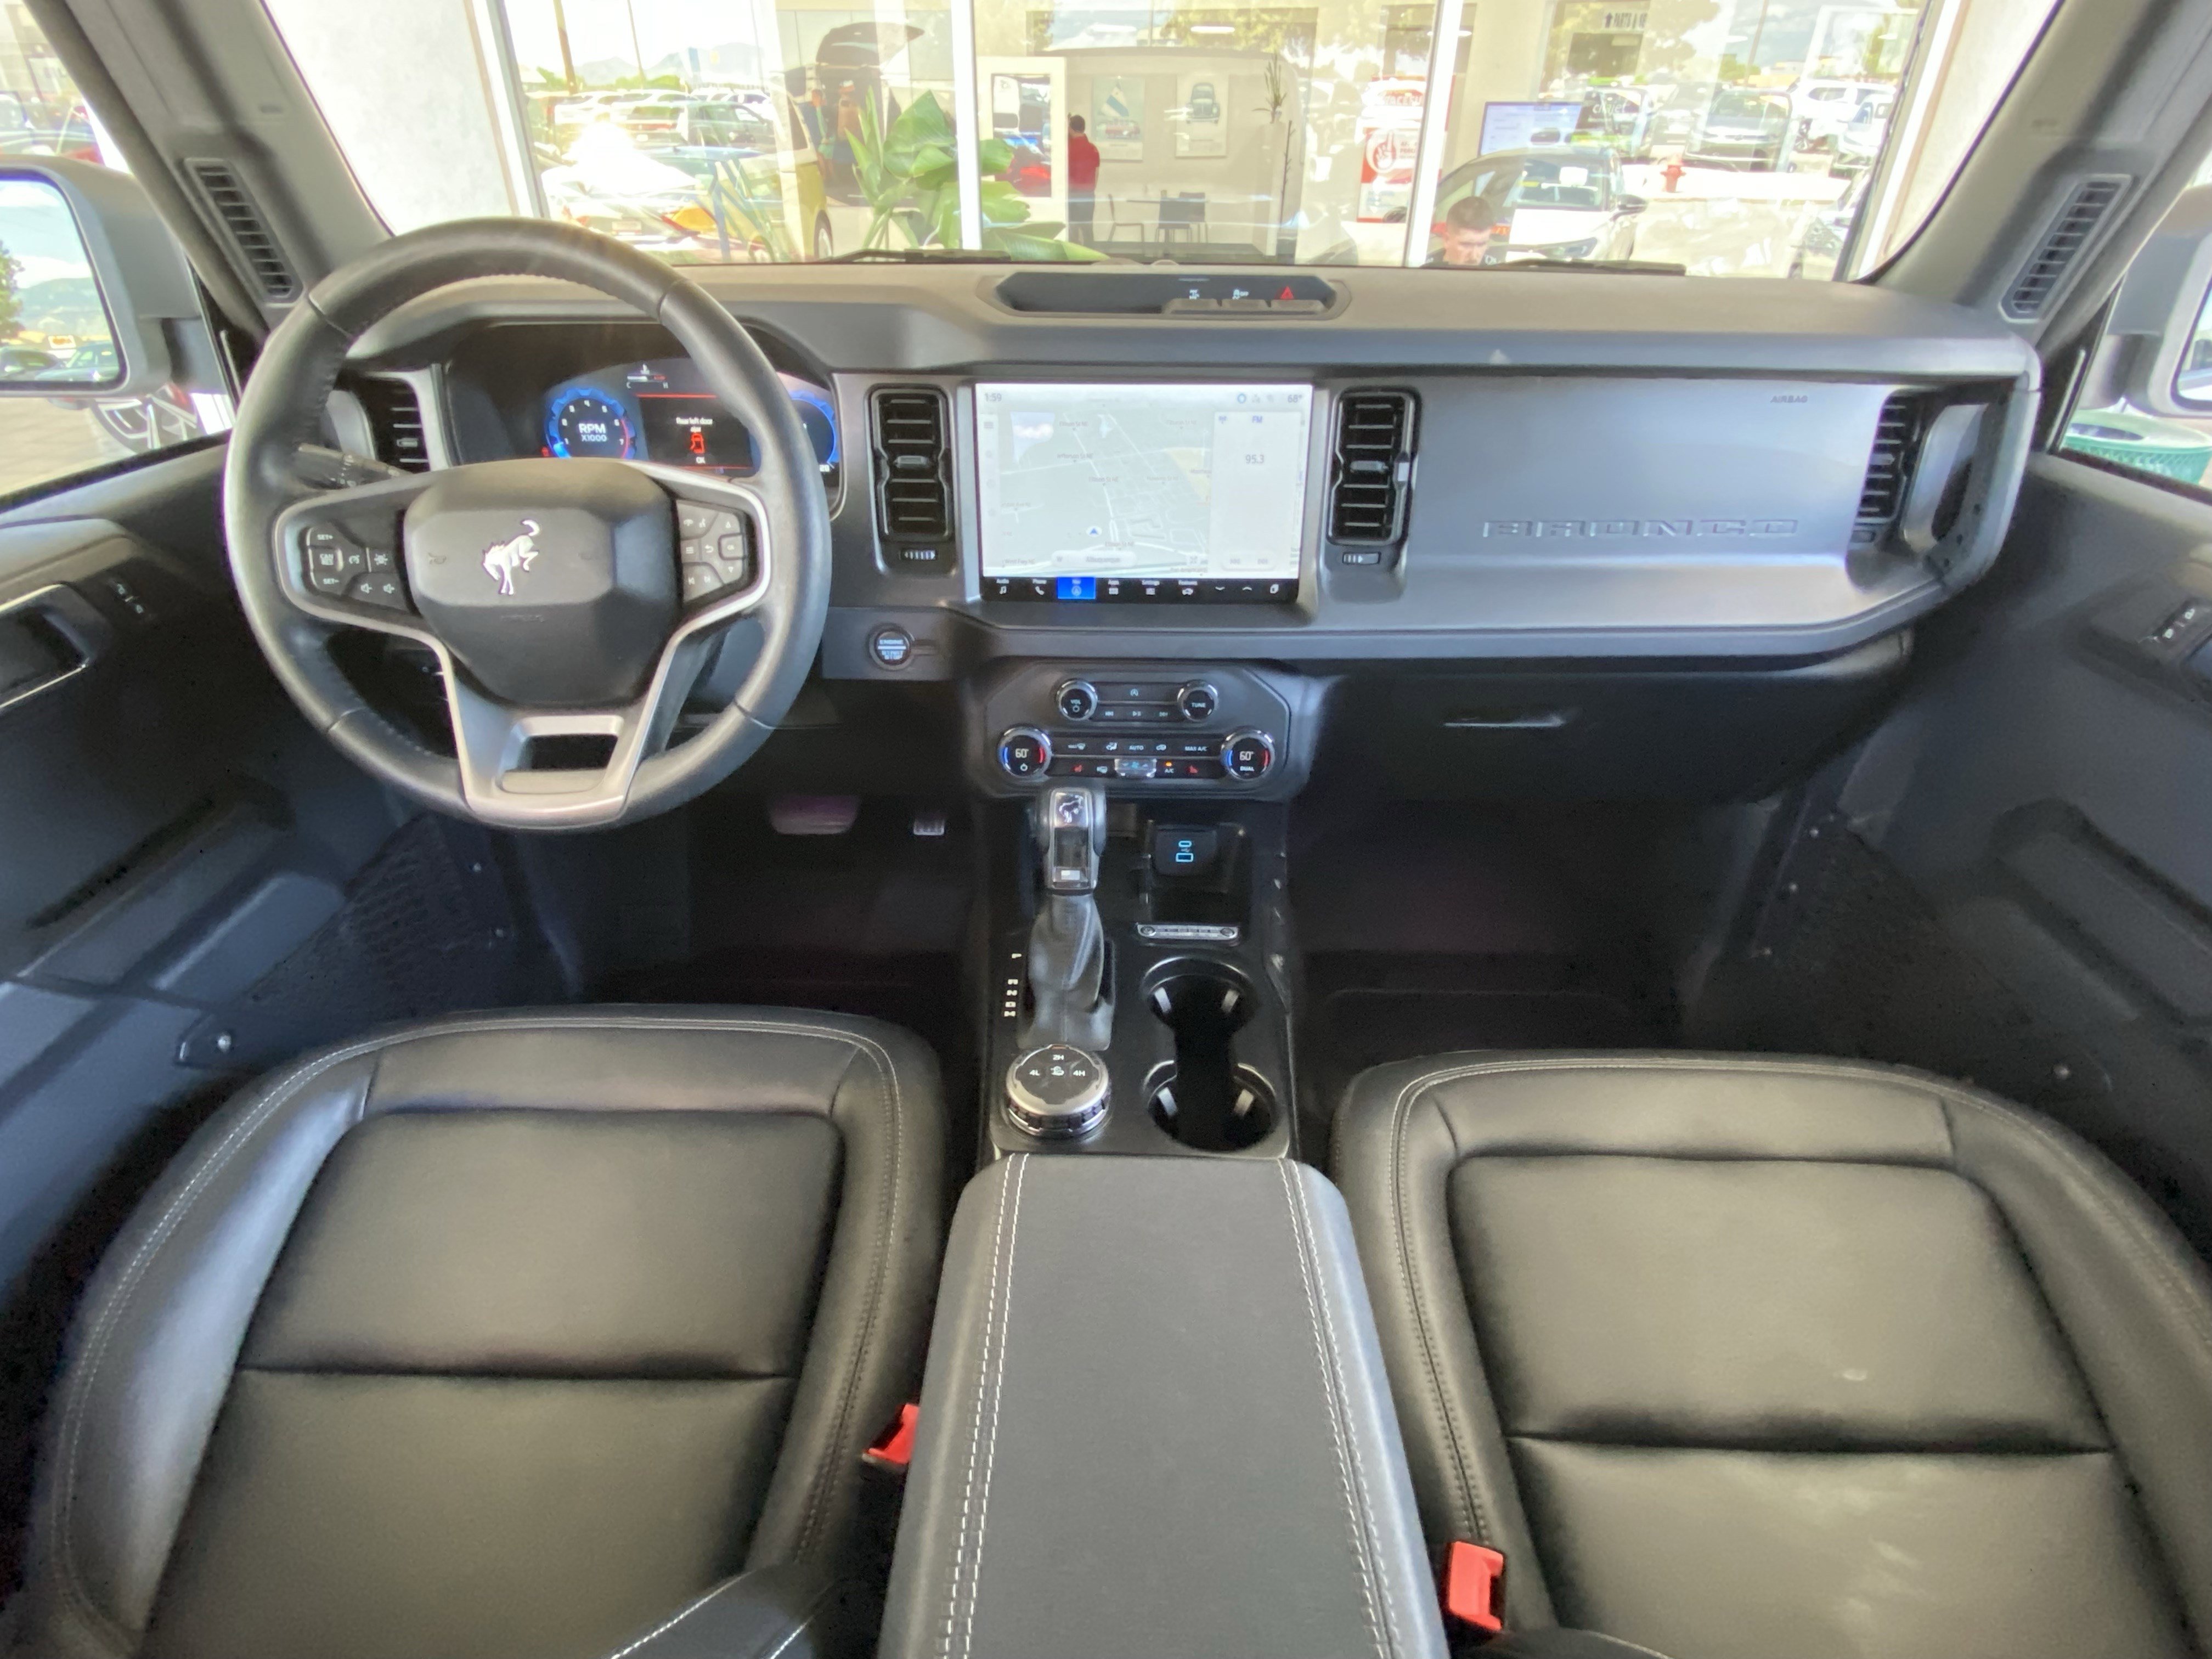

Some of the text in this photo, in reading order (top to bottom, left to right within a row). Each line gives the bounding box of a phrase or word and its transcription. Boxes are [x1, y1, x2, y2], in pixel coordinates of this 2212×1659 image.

[984, 393, 1002, 402] 1:59
[578, 423, 606, 433] RPM
[1245, 455, 1264, 464] 95.3
[1483, 519, 1798, 538] BRONCO
